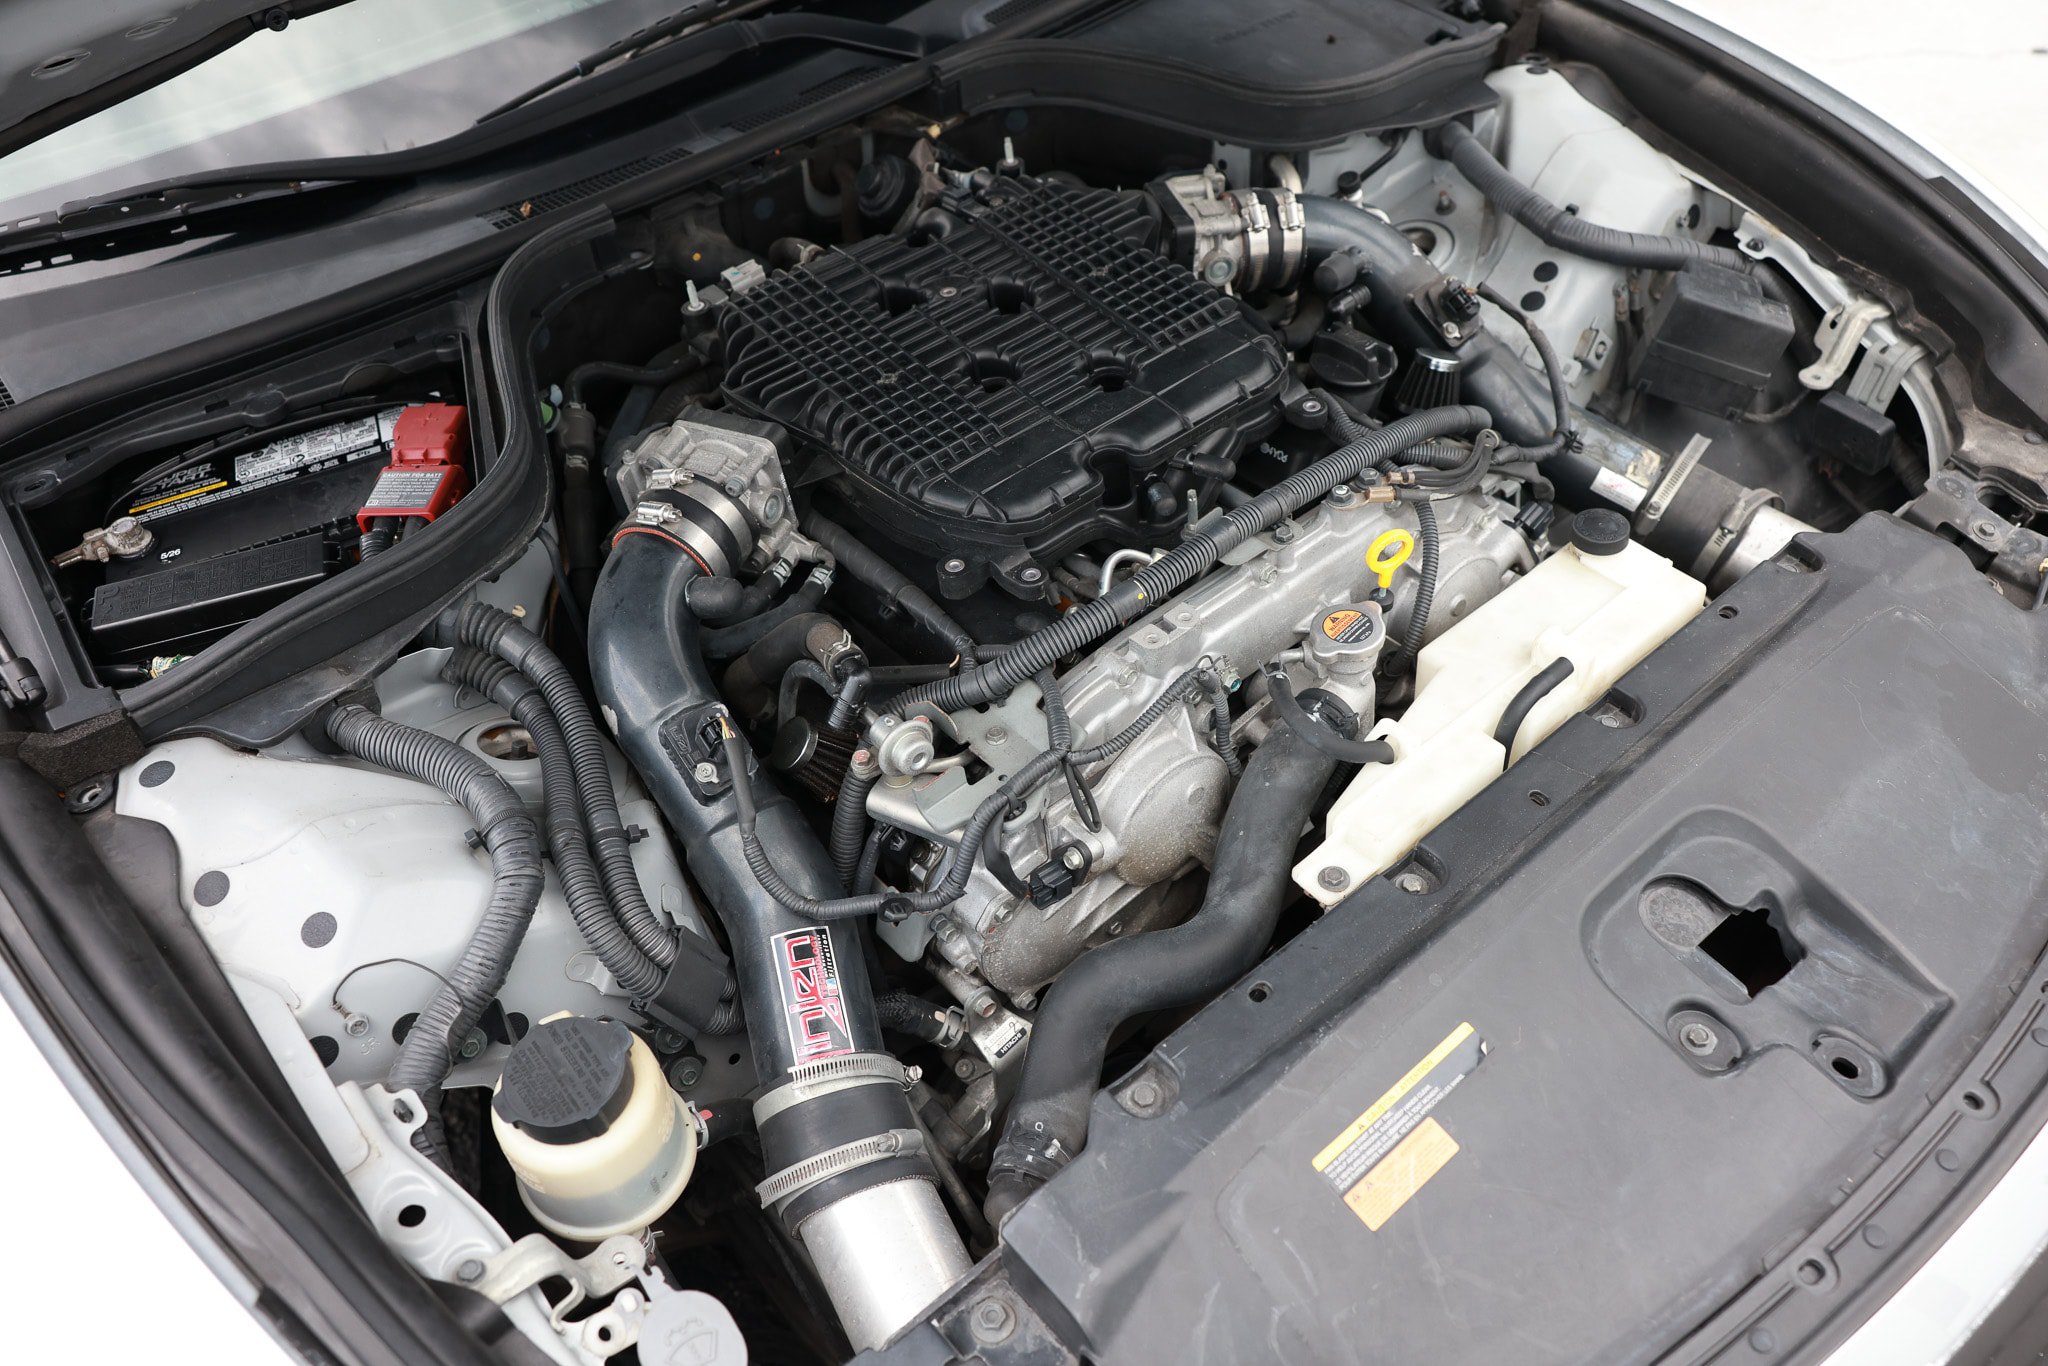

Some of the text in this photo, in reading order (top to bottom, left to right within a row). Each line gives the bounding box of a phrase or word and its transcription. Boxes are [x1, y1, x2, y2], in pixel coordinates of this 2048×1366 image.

[1329, 613, 1350, 631] WARNING
[810, 935, 829, 997] TECHNOLOGY
[822, 934, 834, 978] Filtration
[545, 1023, 563, 1045] POWER
[560, 1045, 585, 1079] STEERING
[582, 1078, 602, 1102] FLUID
[1000, 1032, 1023, 1054] HITACHI
